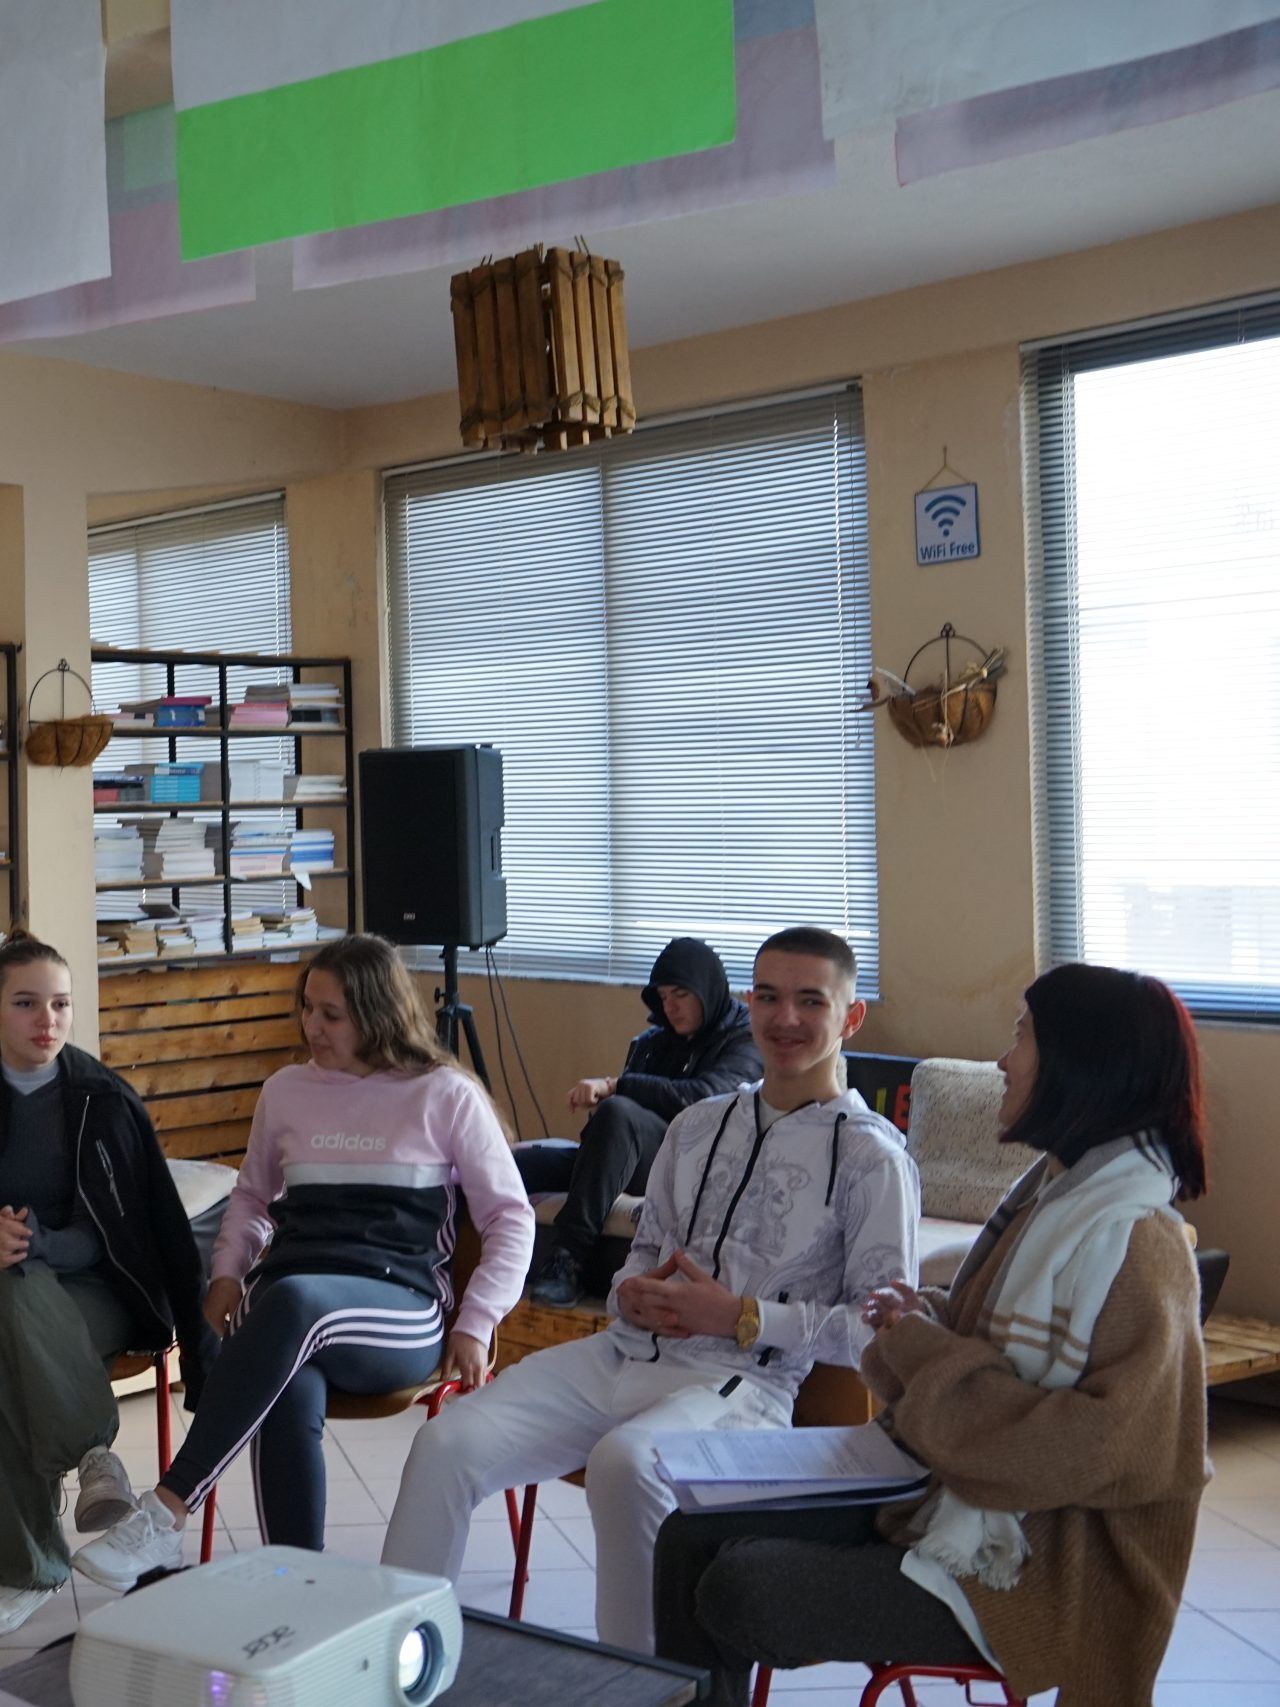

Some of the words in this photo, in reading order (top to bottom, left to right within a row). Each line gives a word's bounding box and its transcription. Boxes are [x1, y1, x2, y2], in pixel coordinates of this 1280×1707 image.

[920, 542, 946, 560] WiFi
[950, 541, 975, 556] Free
[310, 1132, 387, 1152] adidas
